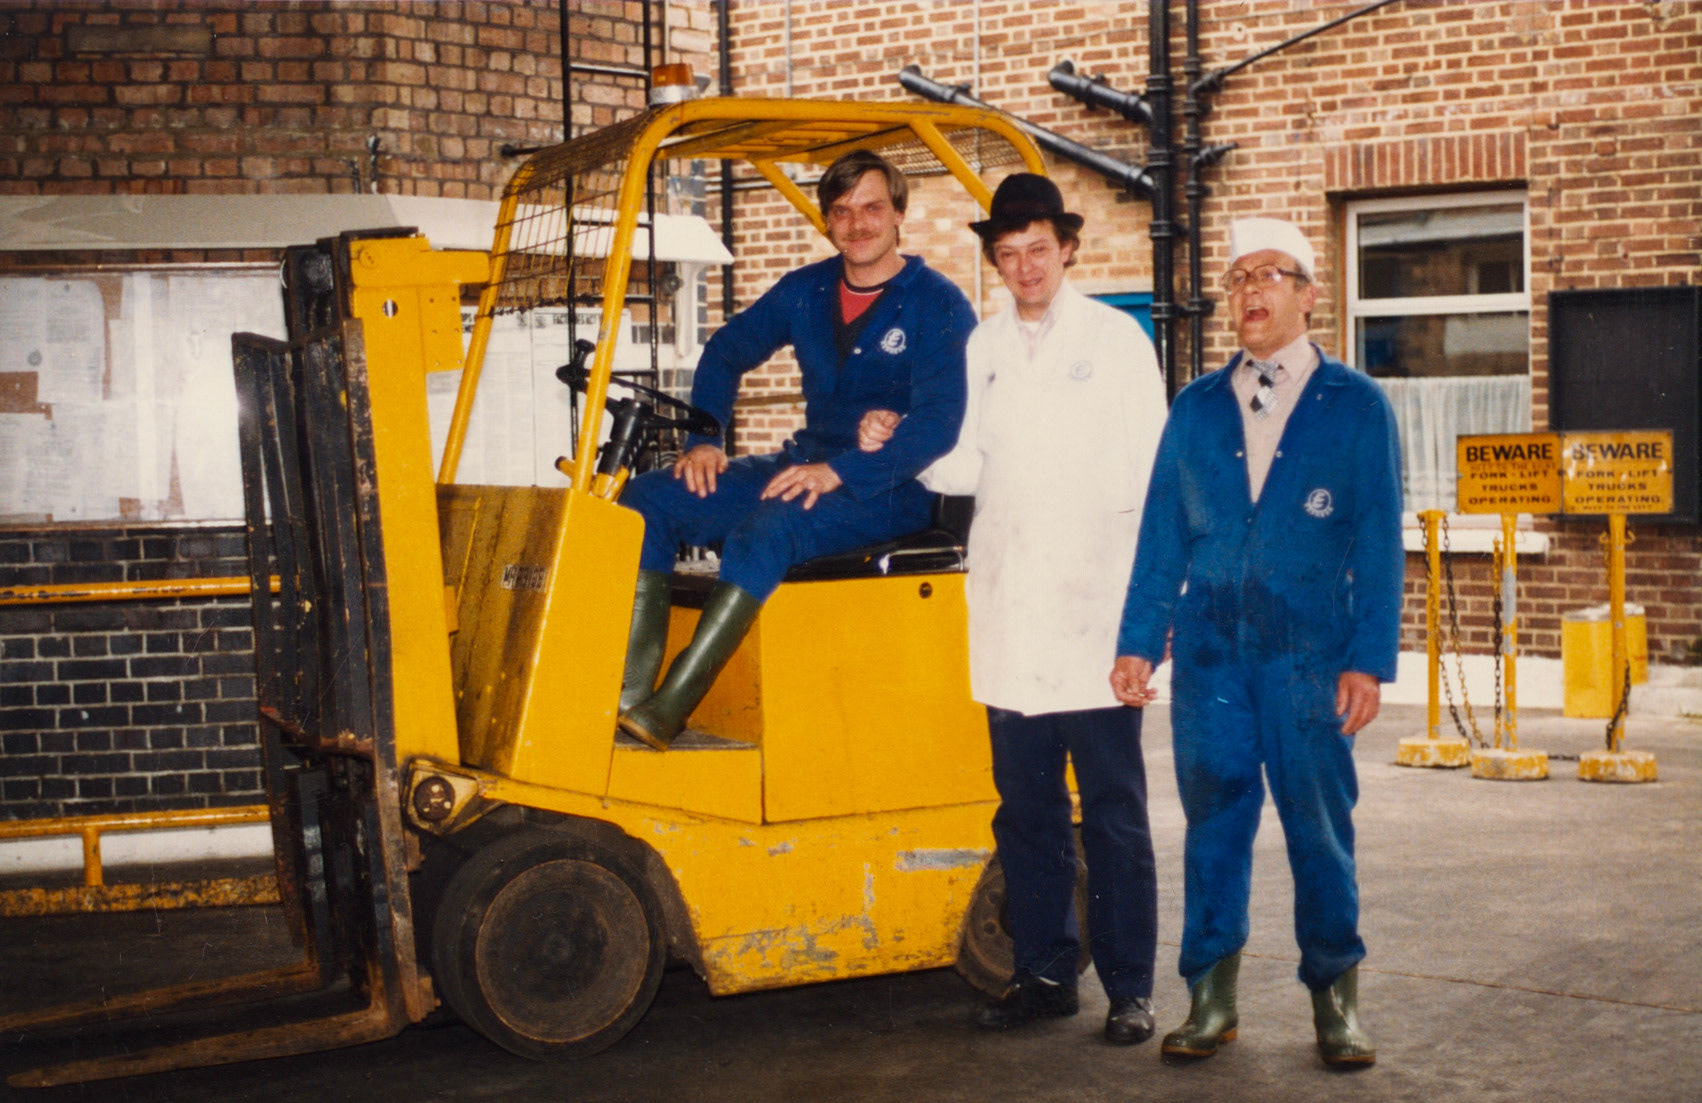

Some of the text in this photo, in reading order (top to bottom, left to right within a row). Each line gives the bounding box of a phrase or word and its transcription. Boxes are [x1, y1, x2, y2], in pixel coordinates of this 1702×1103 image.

[1466, 443, 1553, 462] BEWARE
[1572, 442, 1663, 461] BEWARE
[1470, 472, 1508, 480] FORK
[1520, 470, 1549, 478] LIFT
[1576, 469, 1658, 478] FORK LIFT
[1482, 483, 1538, 491] TRUCKS
[1589, 482, 1647, 491] TRUCKS
[1468, 495, 1552, 505] OPERATING
[1575, 495, 1661, 504] OPERATING
